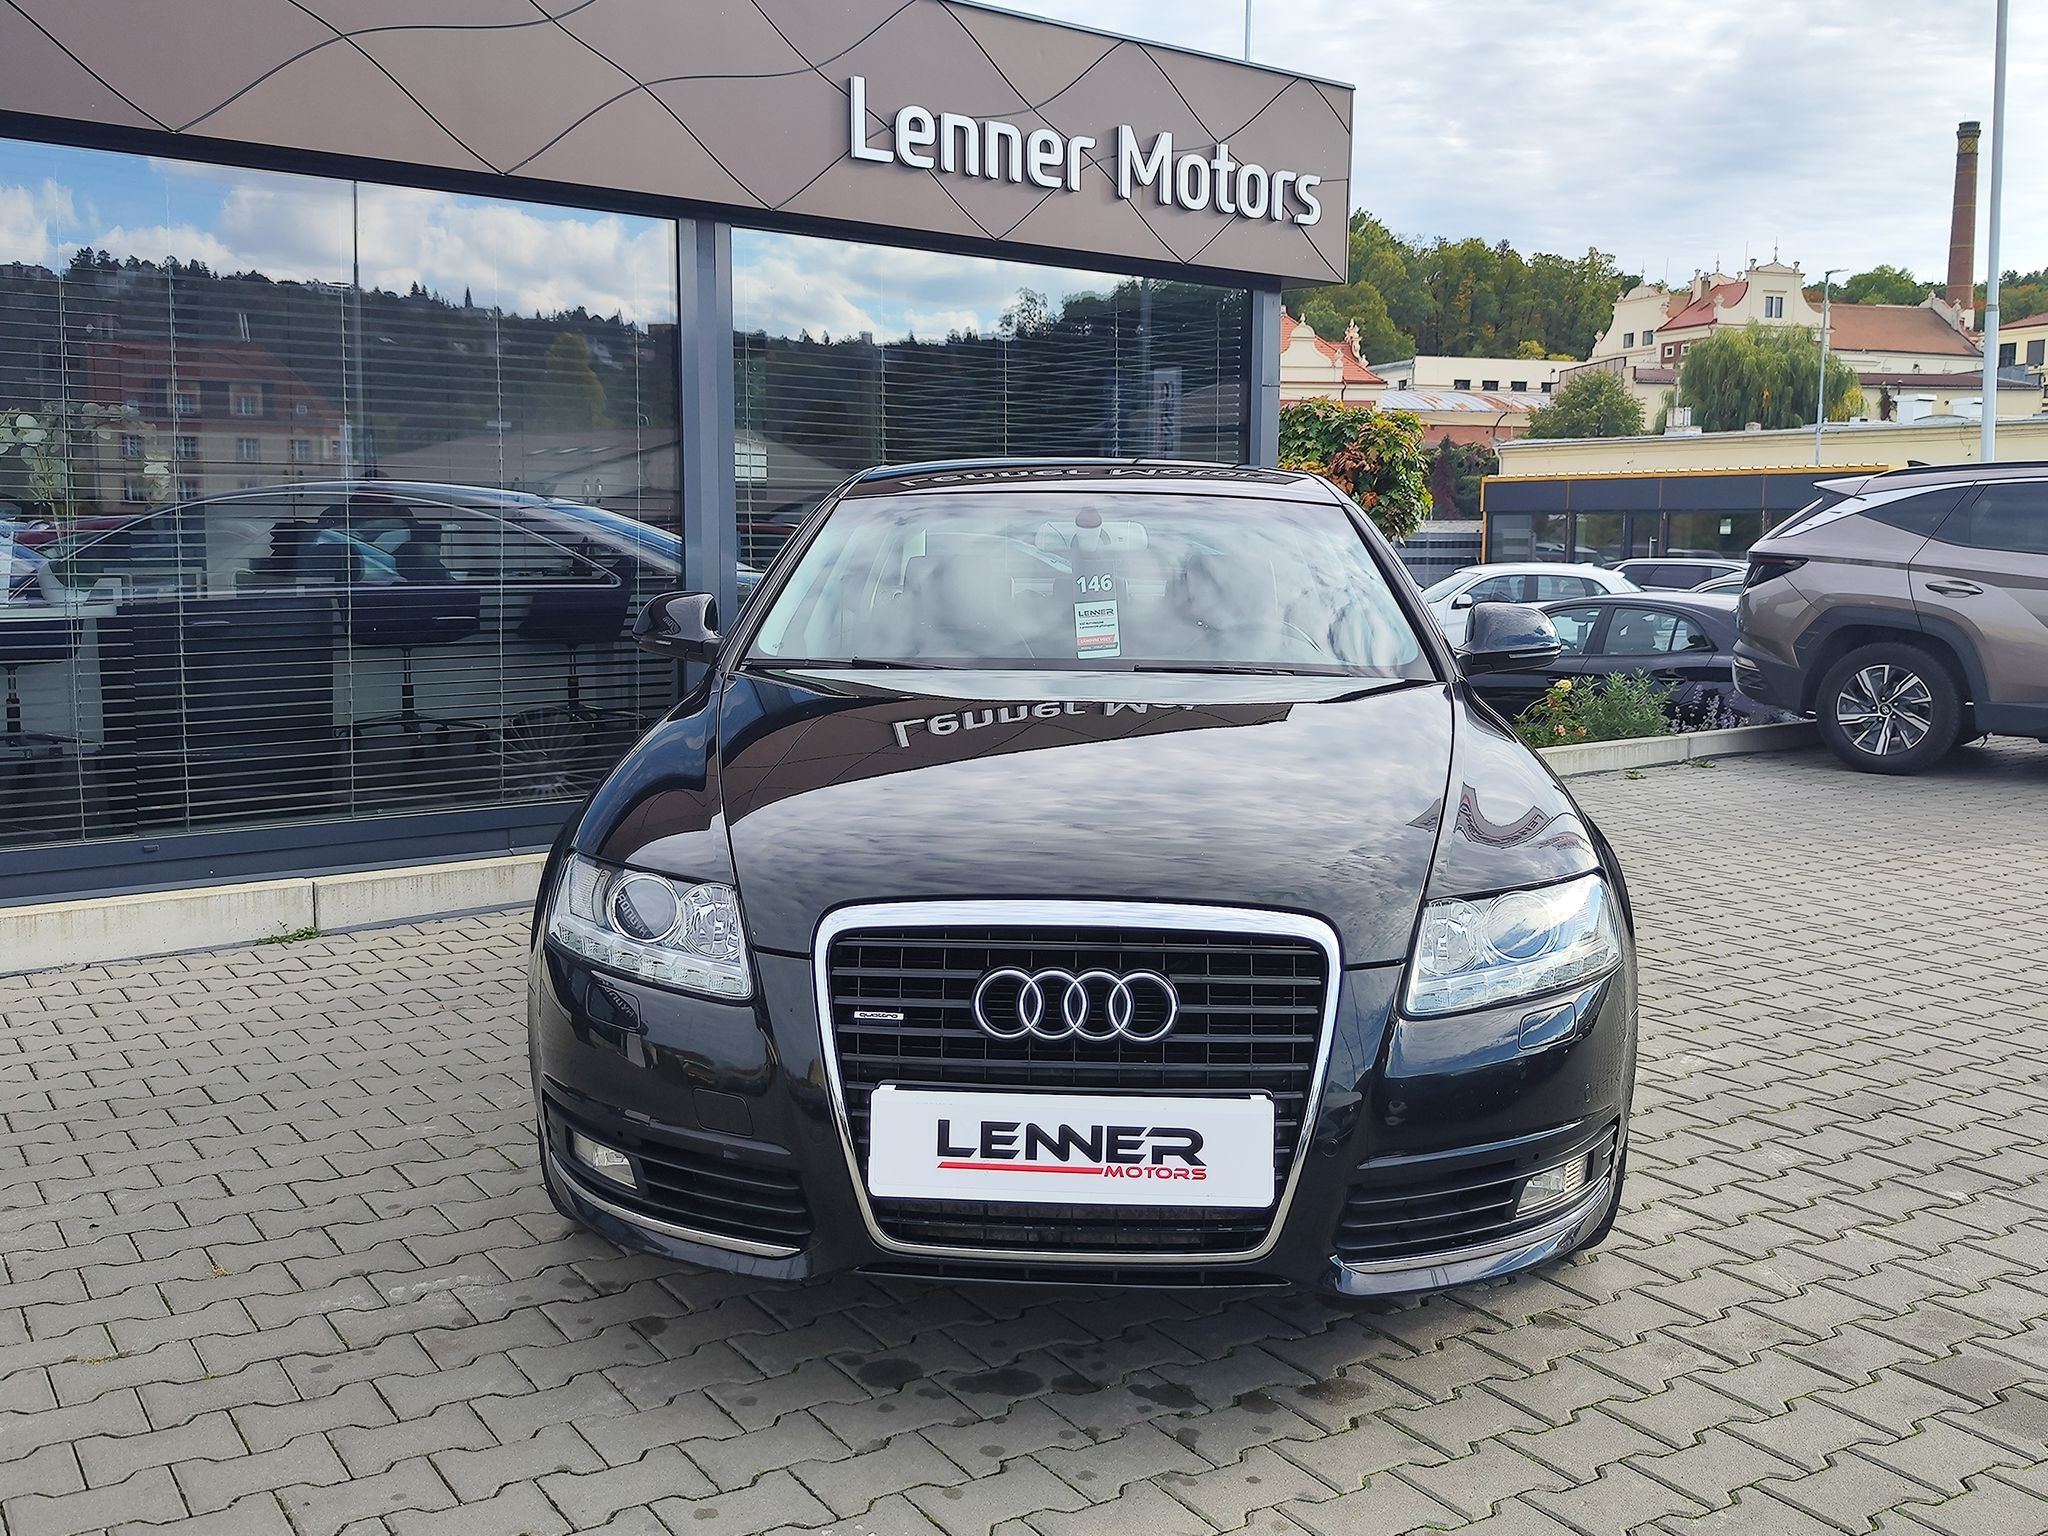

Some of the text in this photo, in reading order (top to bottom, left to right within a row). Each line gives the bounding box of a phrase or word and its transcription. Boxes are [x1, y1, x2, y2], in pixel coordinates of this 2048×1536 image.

[849, 75, 1322, 226] Lenner Motors
[1076, 573, 1113, 593] 146
[1078, 608, 1114, 617] LENNER
[937, 1119, 1207, 1166] LENNER
[1104, 1165, 1207, 1181] MOTORS
